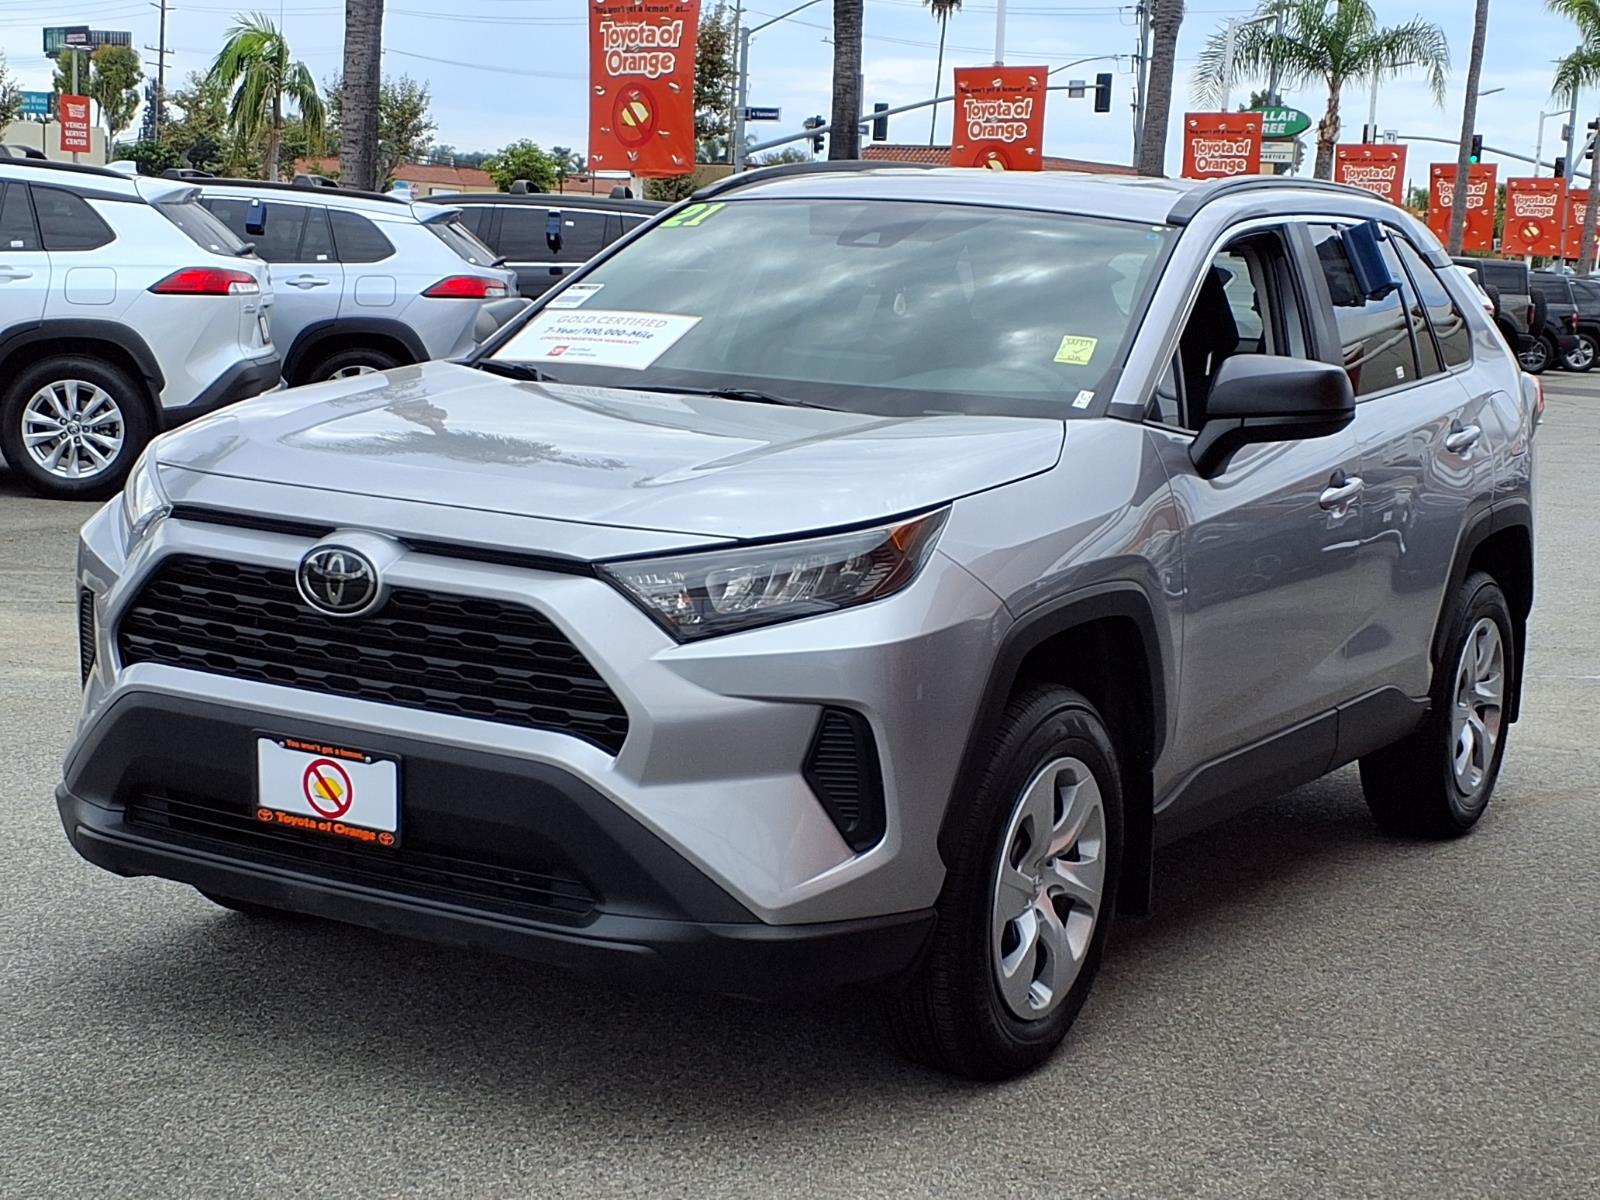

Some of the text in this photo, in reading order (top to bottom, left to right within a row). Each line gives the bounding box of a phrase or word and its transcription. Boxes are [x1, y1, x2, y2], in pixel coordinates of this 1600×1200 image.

[600, 20, 683, 51] Toyota of
[606, 48, 675, 78] Orange
[963, 98, 1033, 121] Toyota of
[1263, 111, 1298, 121] LLAR
[968, 120, 1028, 142] Orange
[1263, 123, 1286, 133] REE
[1192, 138, 1251, 157] Toyota of
[1196, 156, 1247, 174] Orange
[1342, 165, 1396, 180] Toyota of
[1474, 182, 1488, 195] of
[1512, 193, 1558, 206] Toyota of
[660, 203, 726, 226] 21
[1516, 206, 1554, 218] Orange
[557, 315, 668, 328] GOLD CERTIFIED
[275, 811, 376, 841] Toyota of Orange
